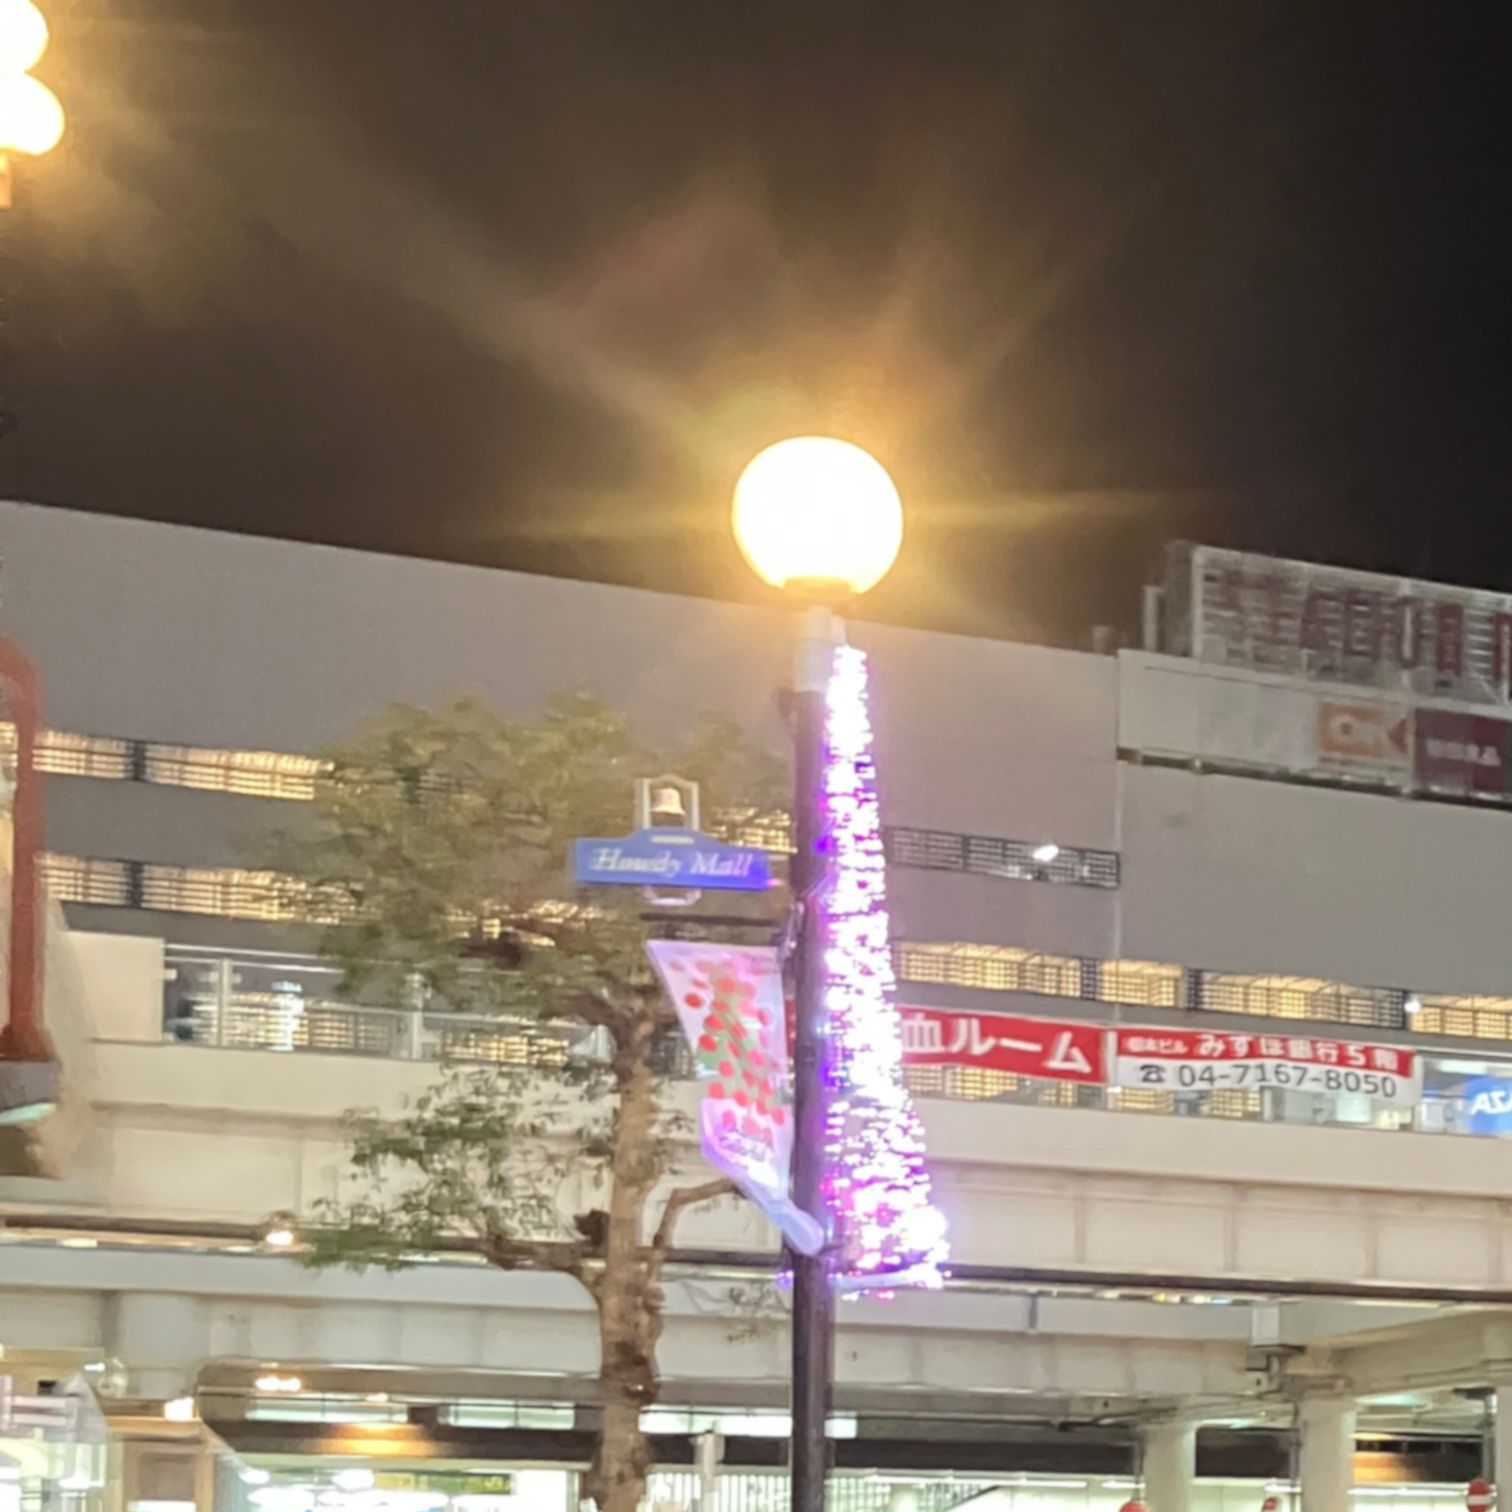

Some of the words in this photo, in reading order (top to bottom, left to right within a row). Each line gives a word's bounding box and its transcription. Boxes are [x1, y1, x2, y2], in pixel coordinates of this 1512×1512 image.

[590, 848, 682, 878] Howdy
[691, 852, 754, 877] Mall
[1178, 1063, 1397, 1097] 04-7167-8050
